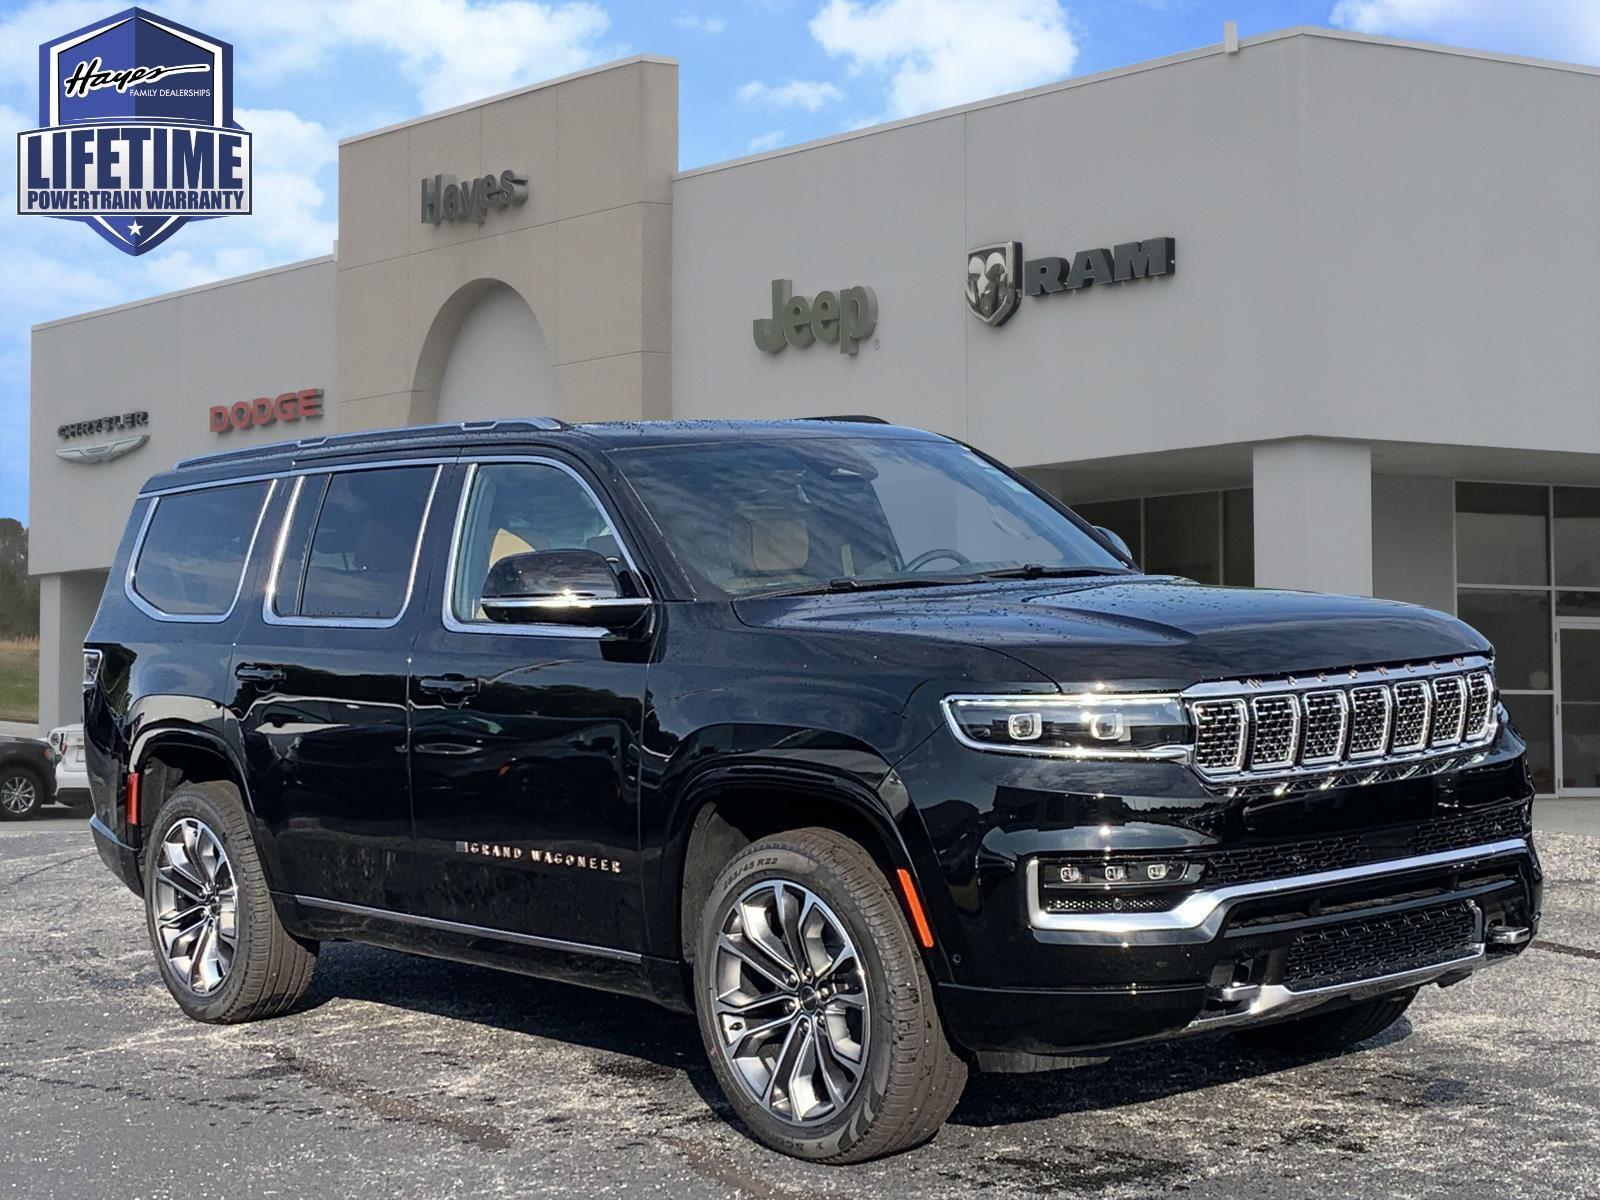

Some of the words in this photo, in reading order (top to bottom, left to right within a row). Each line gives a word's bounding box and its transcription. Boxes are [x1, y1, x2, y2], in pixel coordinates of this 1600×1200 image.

[421, 169, 529, 226] Hayes
[1024, 237, 1176, 296] RAM
[753, 278, 878, 355] Jeep
[57, 411, 149, 439] CHRYSLER
[209, 388, 324, 434] DODGE
[470, 843, 522, 859] GRAND
[531, 850, 621, 873] WAGONEER
